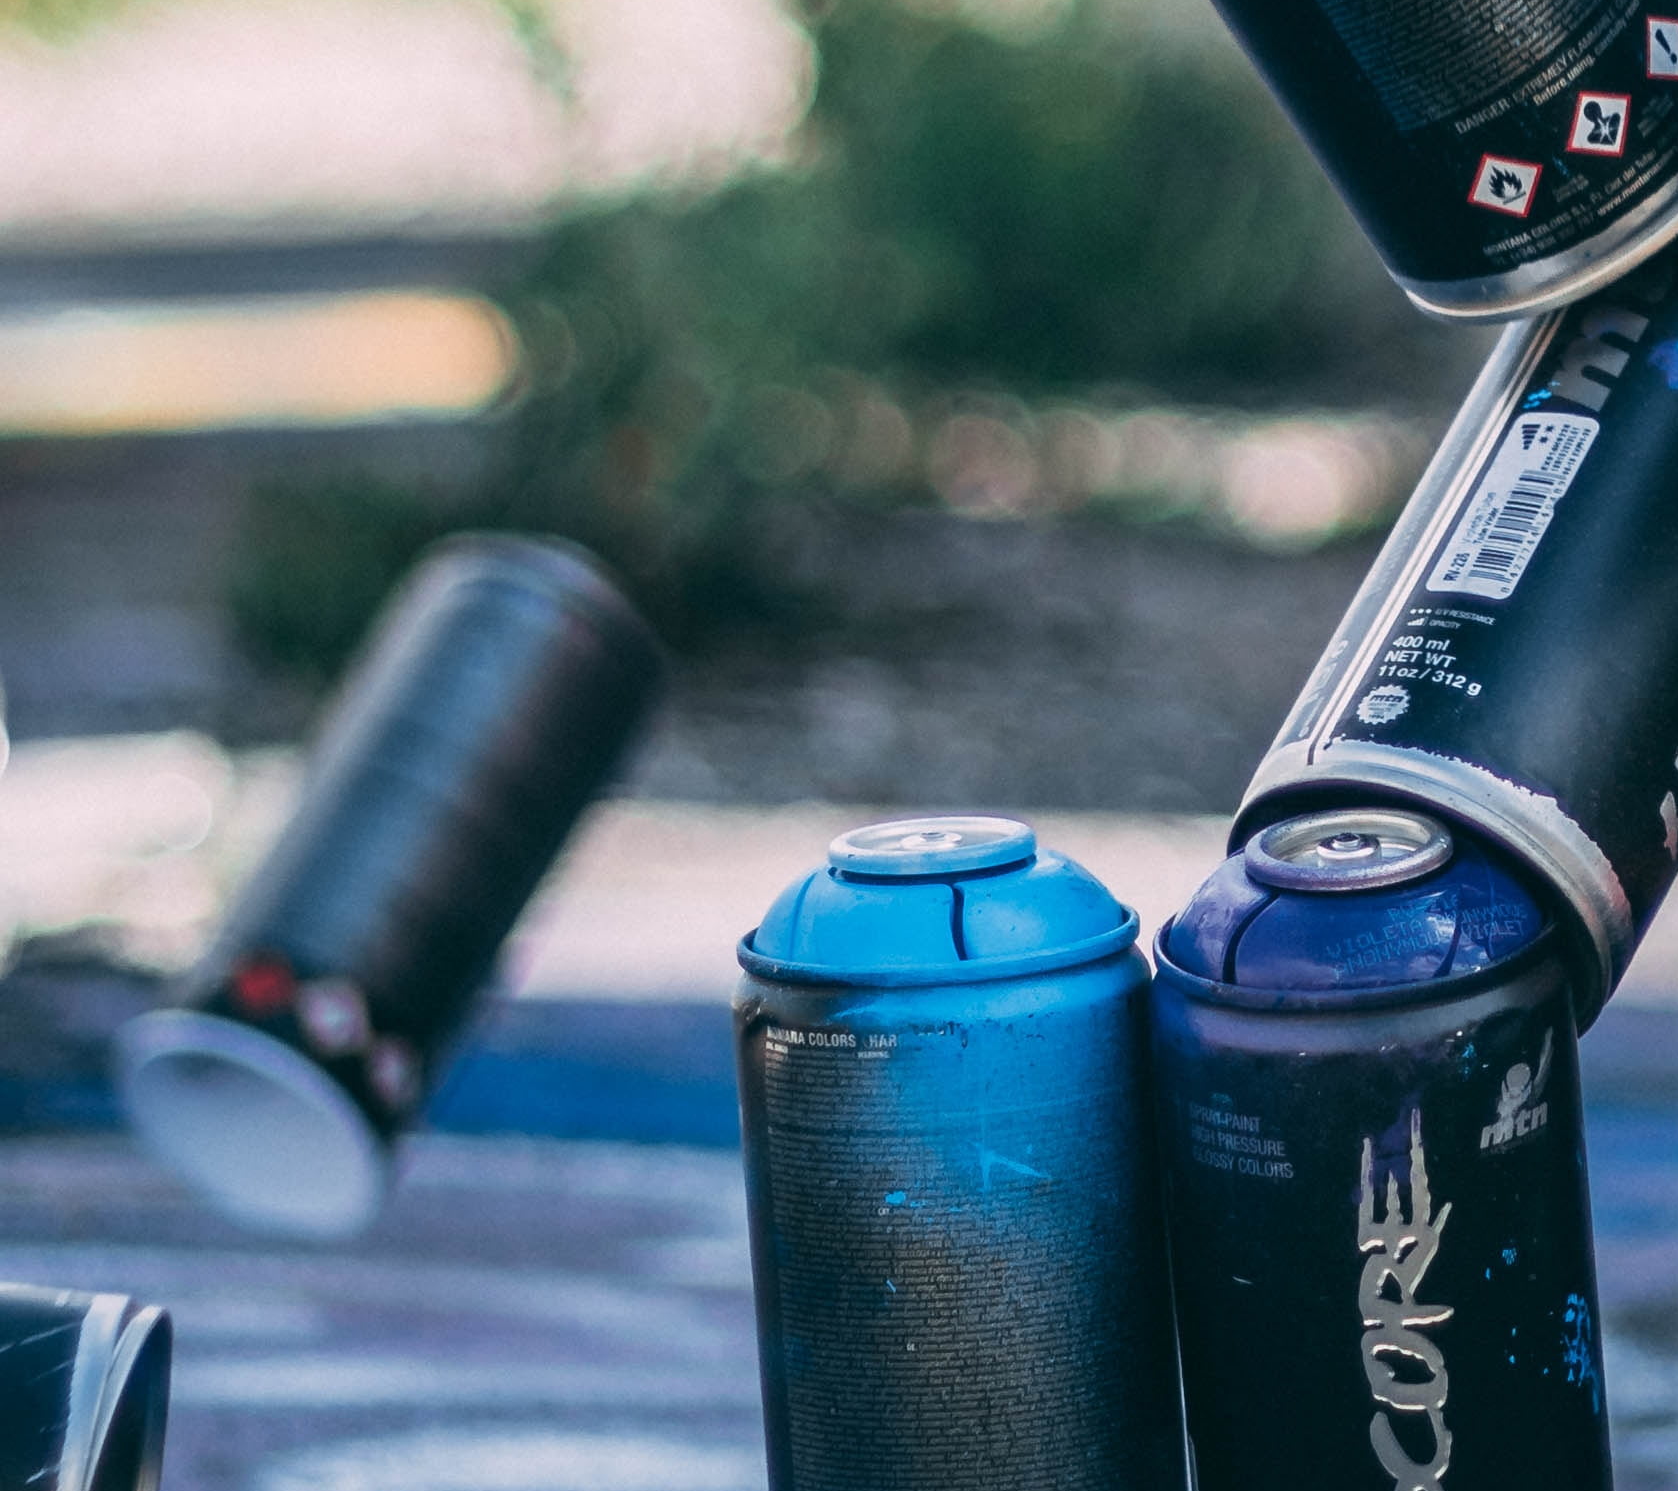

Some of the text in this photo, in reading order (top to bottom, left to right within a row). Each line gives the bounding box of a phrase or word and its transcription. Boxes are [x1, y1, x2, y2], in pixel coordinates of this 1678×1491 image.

[1511, 53, 1570, 104] EXTREMELY
[1532, 75, 1568, 106] Before
[1483, 230, 1532, 258] MONTANA
[1392, 633, 1450, 651] 400 ml
[1384, 650, 1456, 668] NET WT
[1432, 670, 1466, 688] 312
[1467, 682, 1482, 696] g
[1326, 918, 1422, 957] VIOLETA
[808, 1032, 857, 1047] COLORS
[1226, 1113, 1261, 1132] PAINT
[1480, 1101, 1548, 1149] mtn
[1218, 1131, 1287, 1156] PRESSURE
[1238, 1157, 1294, 1178] COLORS
